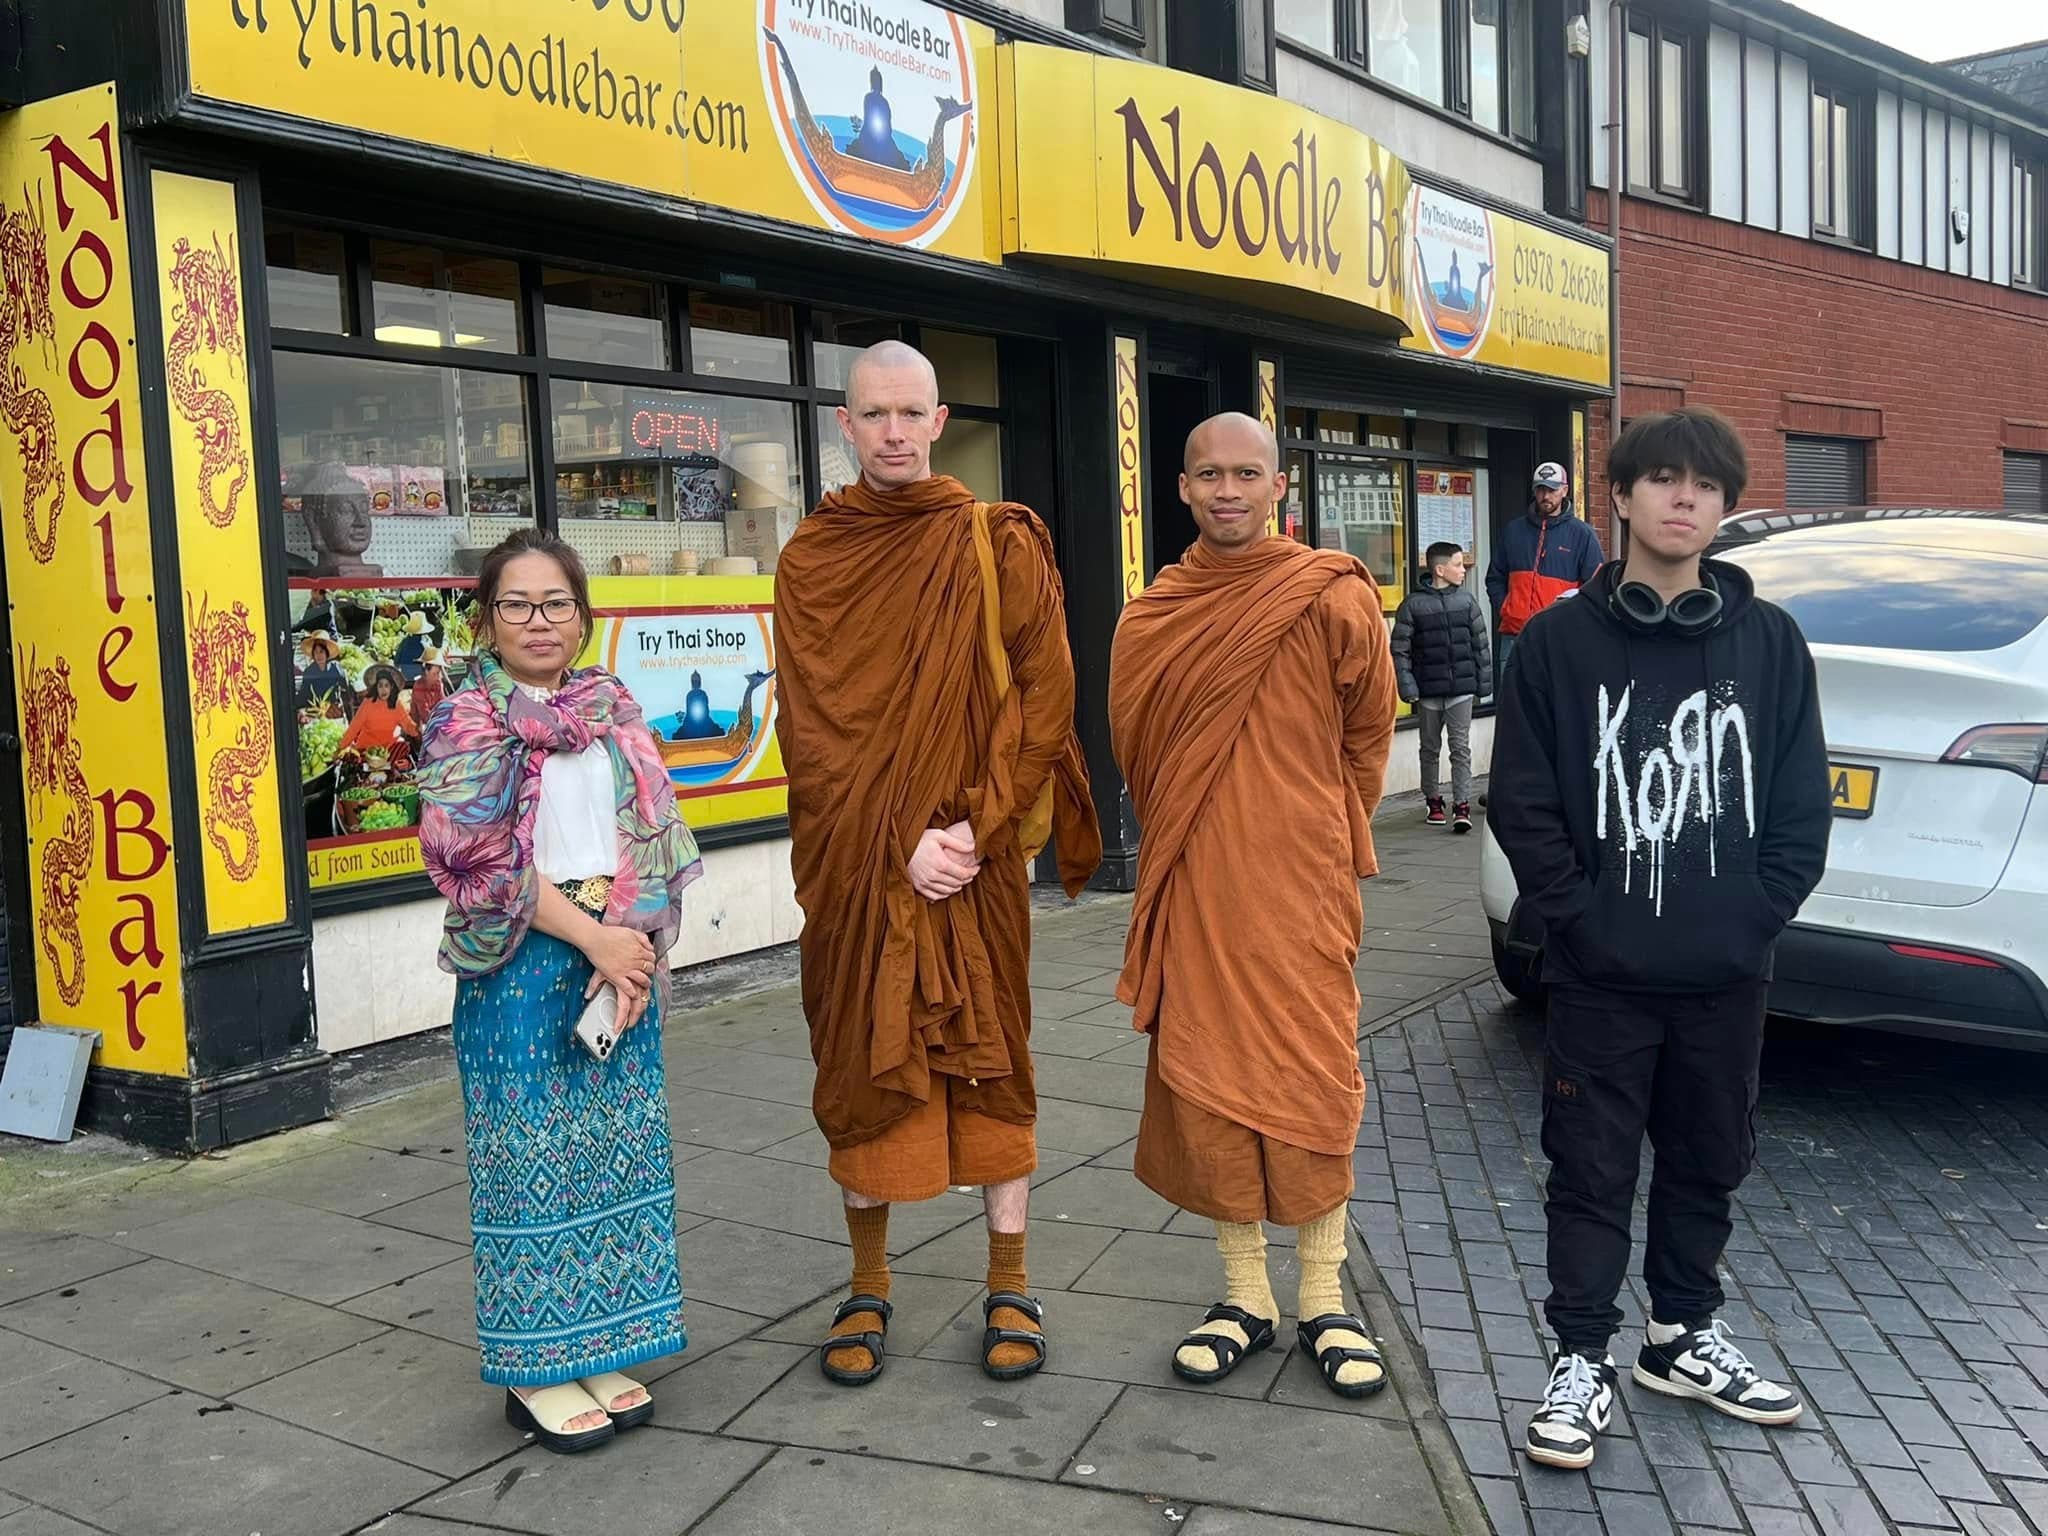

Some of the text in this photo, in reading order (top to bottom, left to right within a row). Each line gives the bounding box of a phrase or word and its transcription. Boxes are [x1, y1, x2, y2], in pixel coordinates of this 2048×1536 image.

[789, 18, 951, 83] www.TryThaiNoodleBar.com
[861, 4, 921, 50] Noodle
[923, 27, 950, 60] Bar
[1115, 96, 1342, 275] Noodle
[1513, 244, 1605, 309] 01978 266586
[632, 410, 718, 451] OPEN
[1117, 351, 1139, 600] Noodle
[40, 121, 171, 1051] Noodle Bar
[638, 627, 746, 655] Try Thai Shop
[640, 653, 747, 669] www.trythaishop.com
[328, 851, 363, 881] from
[371, 843, 416, 869] South
